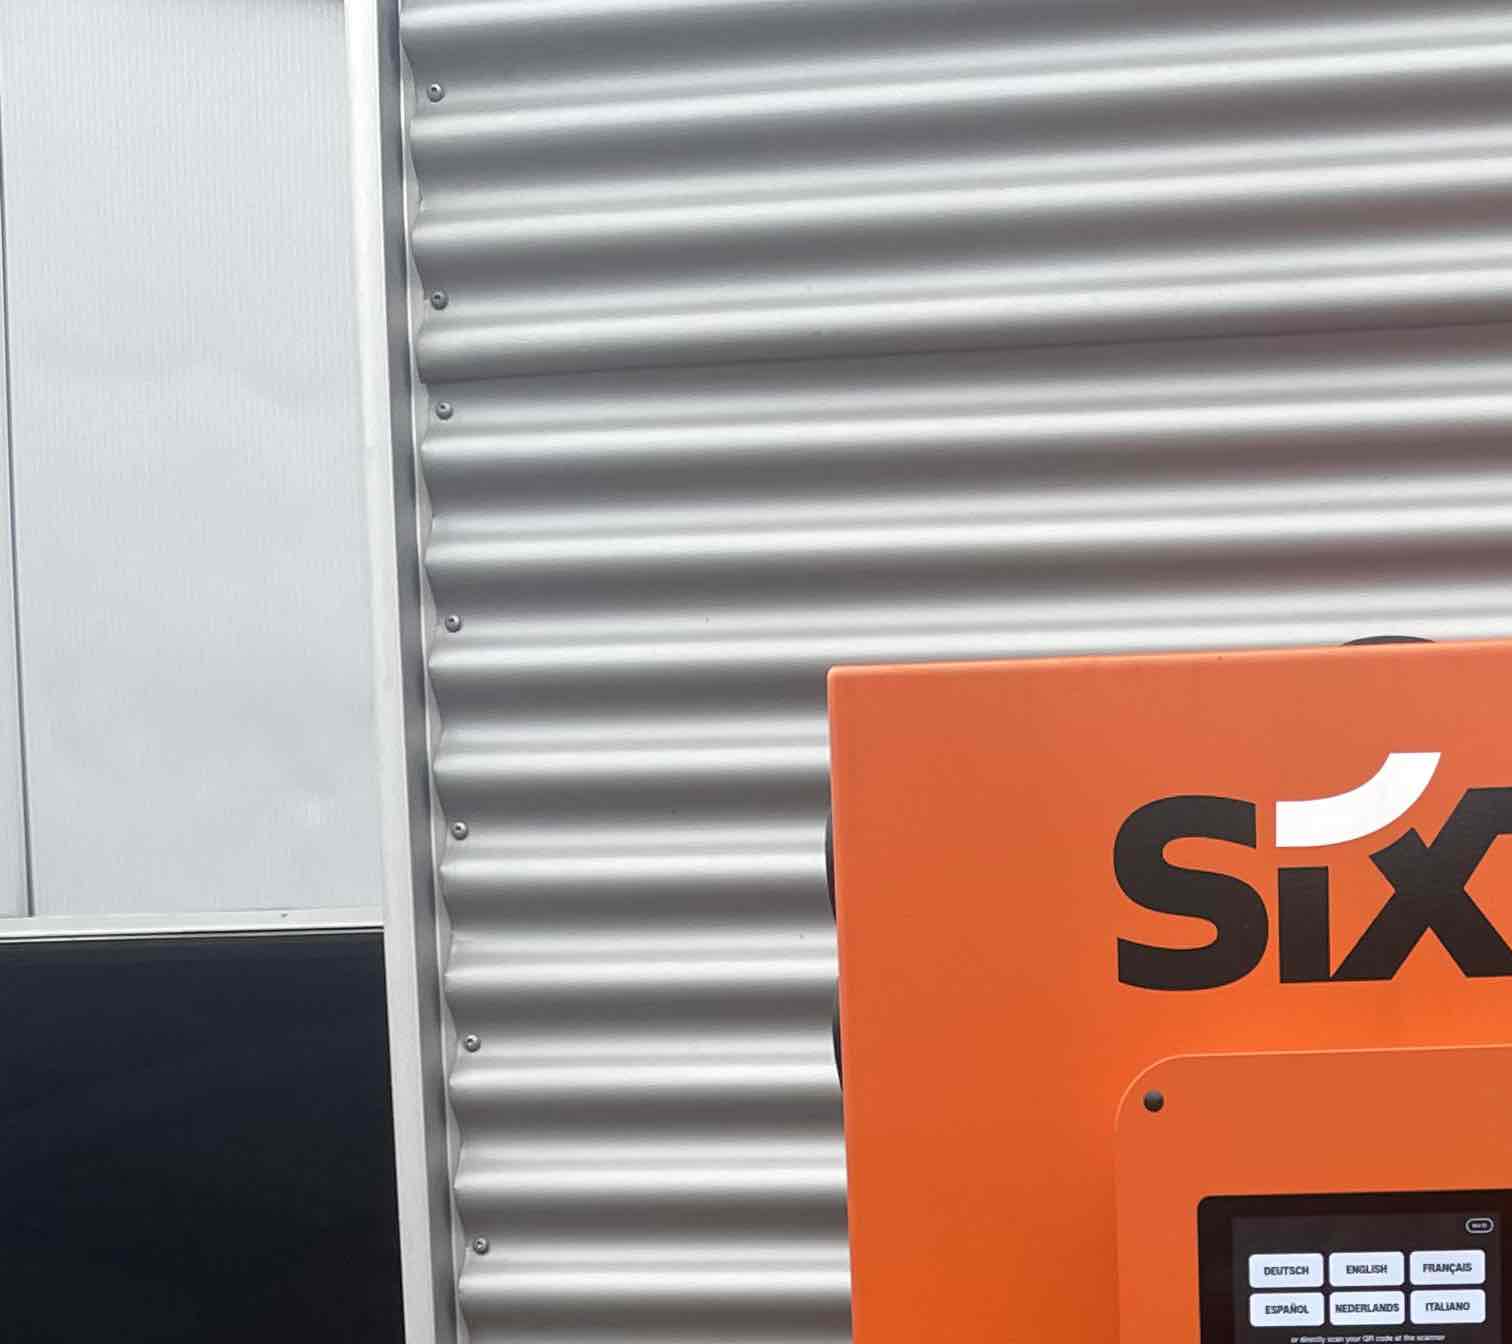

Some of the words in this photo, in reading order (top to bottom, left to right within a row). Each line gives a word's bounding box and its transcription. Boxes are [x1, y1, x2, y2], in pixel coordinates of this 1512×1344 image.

[1263, 1265, 1310, 1276] DEUTSCH
[1345, 1263, 1388, 1275] ENGLISH
[1422, 1262, 1473, 1275] FRANÇAIS
[1264, 1301, 1310, 1315] ESPAÑOL
[1335, 1302, 1400, 1313] NEDERLANDS
[1424, 1301, 1471, 1312] ITALIANO
[1300, 1335, 1326, 1344] directly
[1345, 1336, 1362, 1344] your
[1362, 1334, 1375, 1343] QR
[1375, 1334, 1393, 1343] code
[1403, 1334, 1416, 1342] the
[1416, 1334, 1446, 1342] scanner
